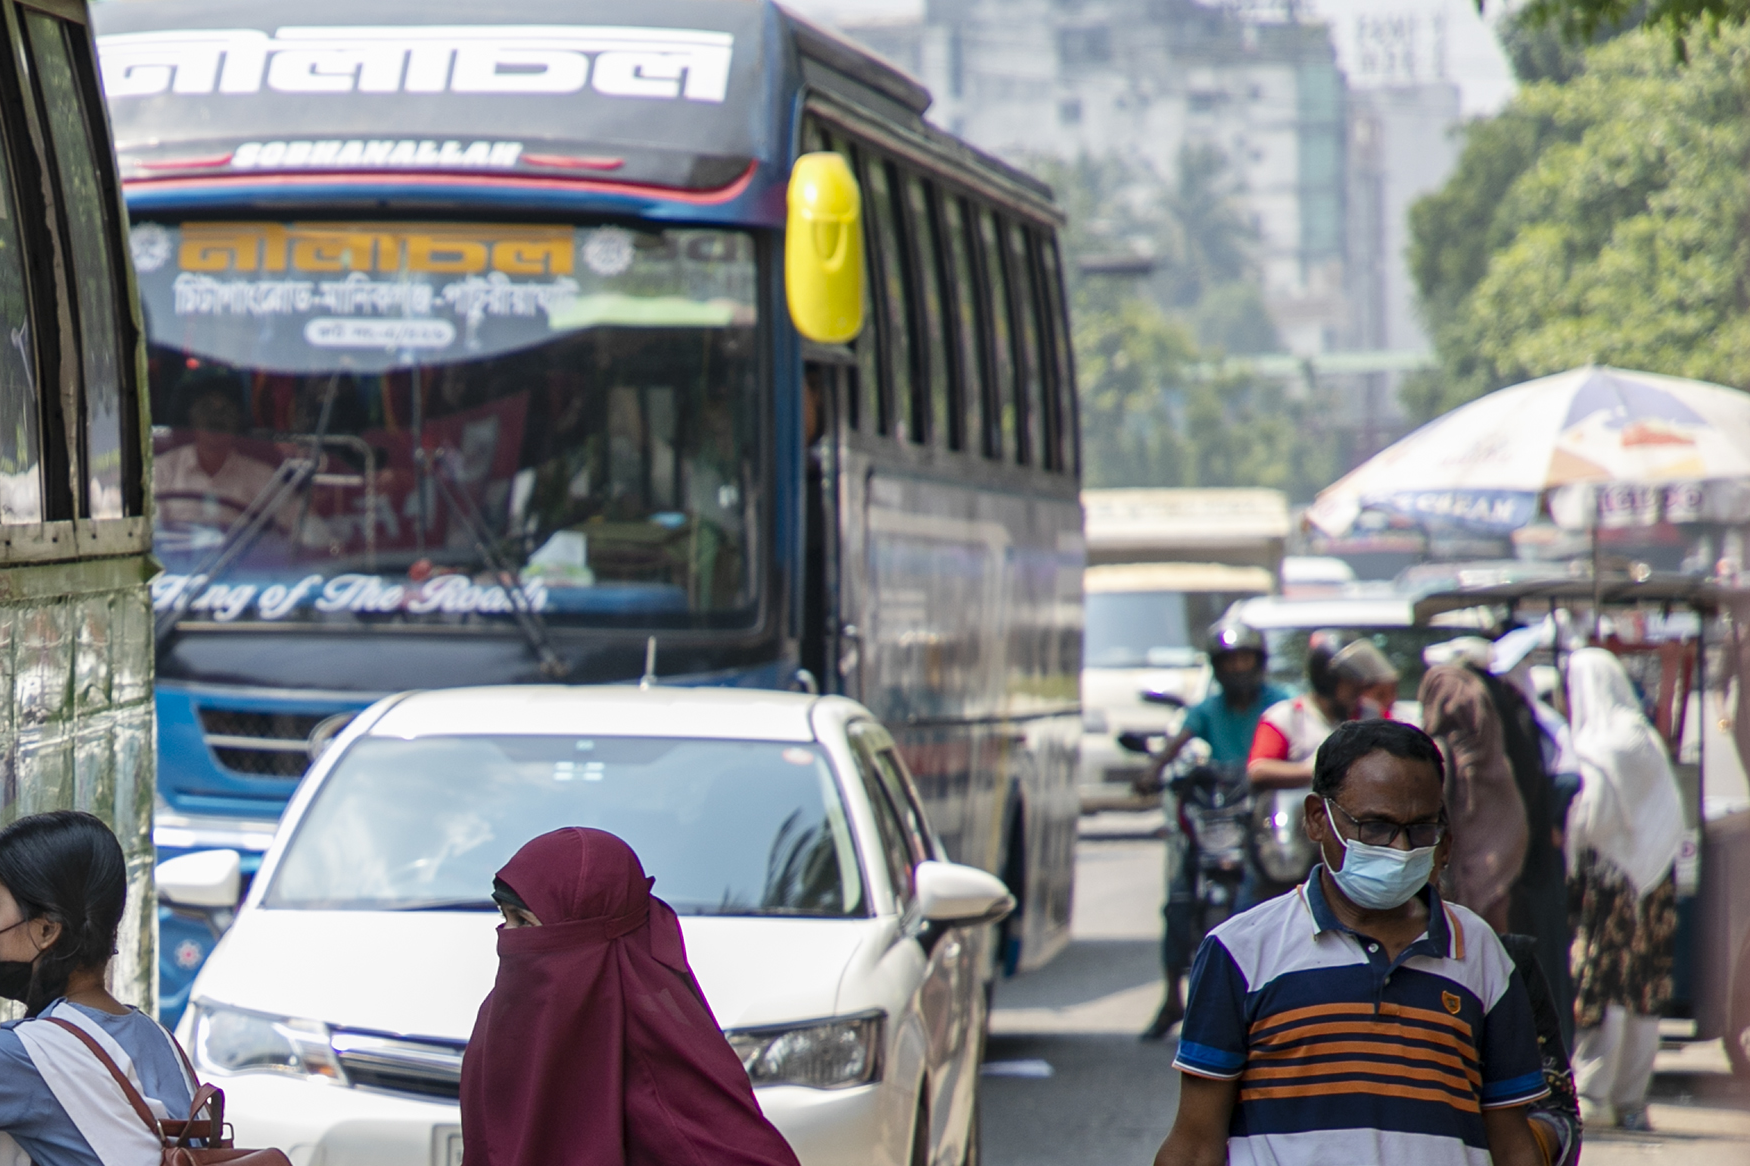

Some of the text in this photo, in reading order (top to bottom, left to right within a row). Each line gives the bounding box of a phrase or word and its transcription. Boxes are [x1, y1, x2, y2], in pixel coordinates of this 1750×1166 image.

[231, 140, 523, 167] SOBHANALLAH
[178, 220, 575, 273] নীলাচল
[152, 574, 257, 621] Kng
[258, 574, 324, 620] of
[315, 573, 403, 613] The
